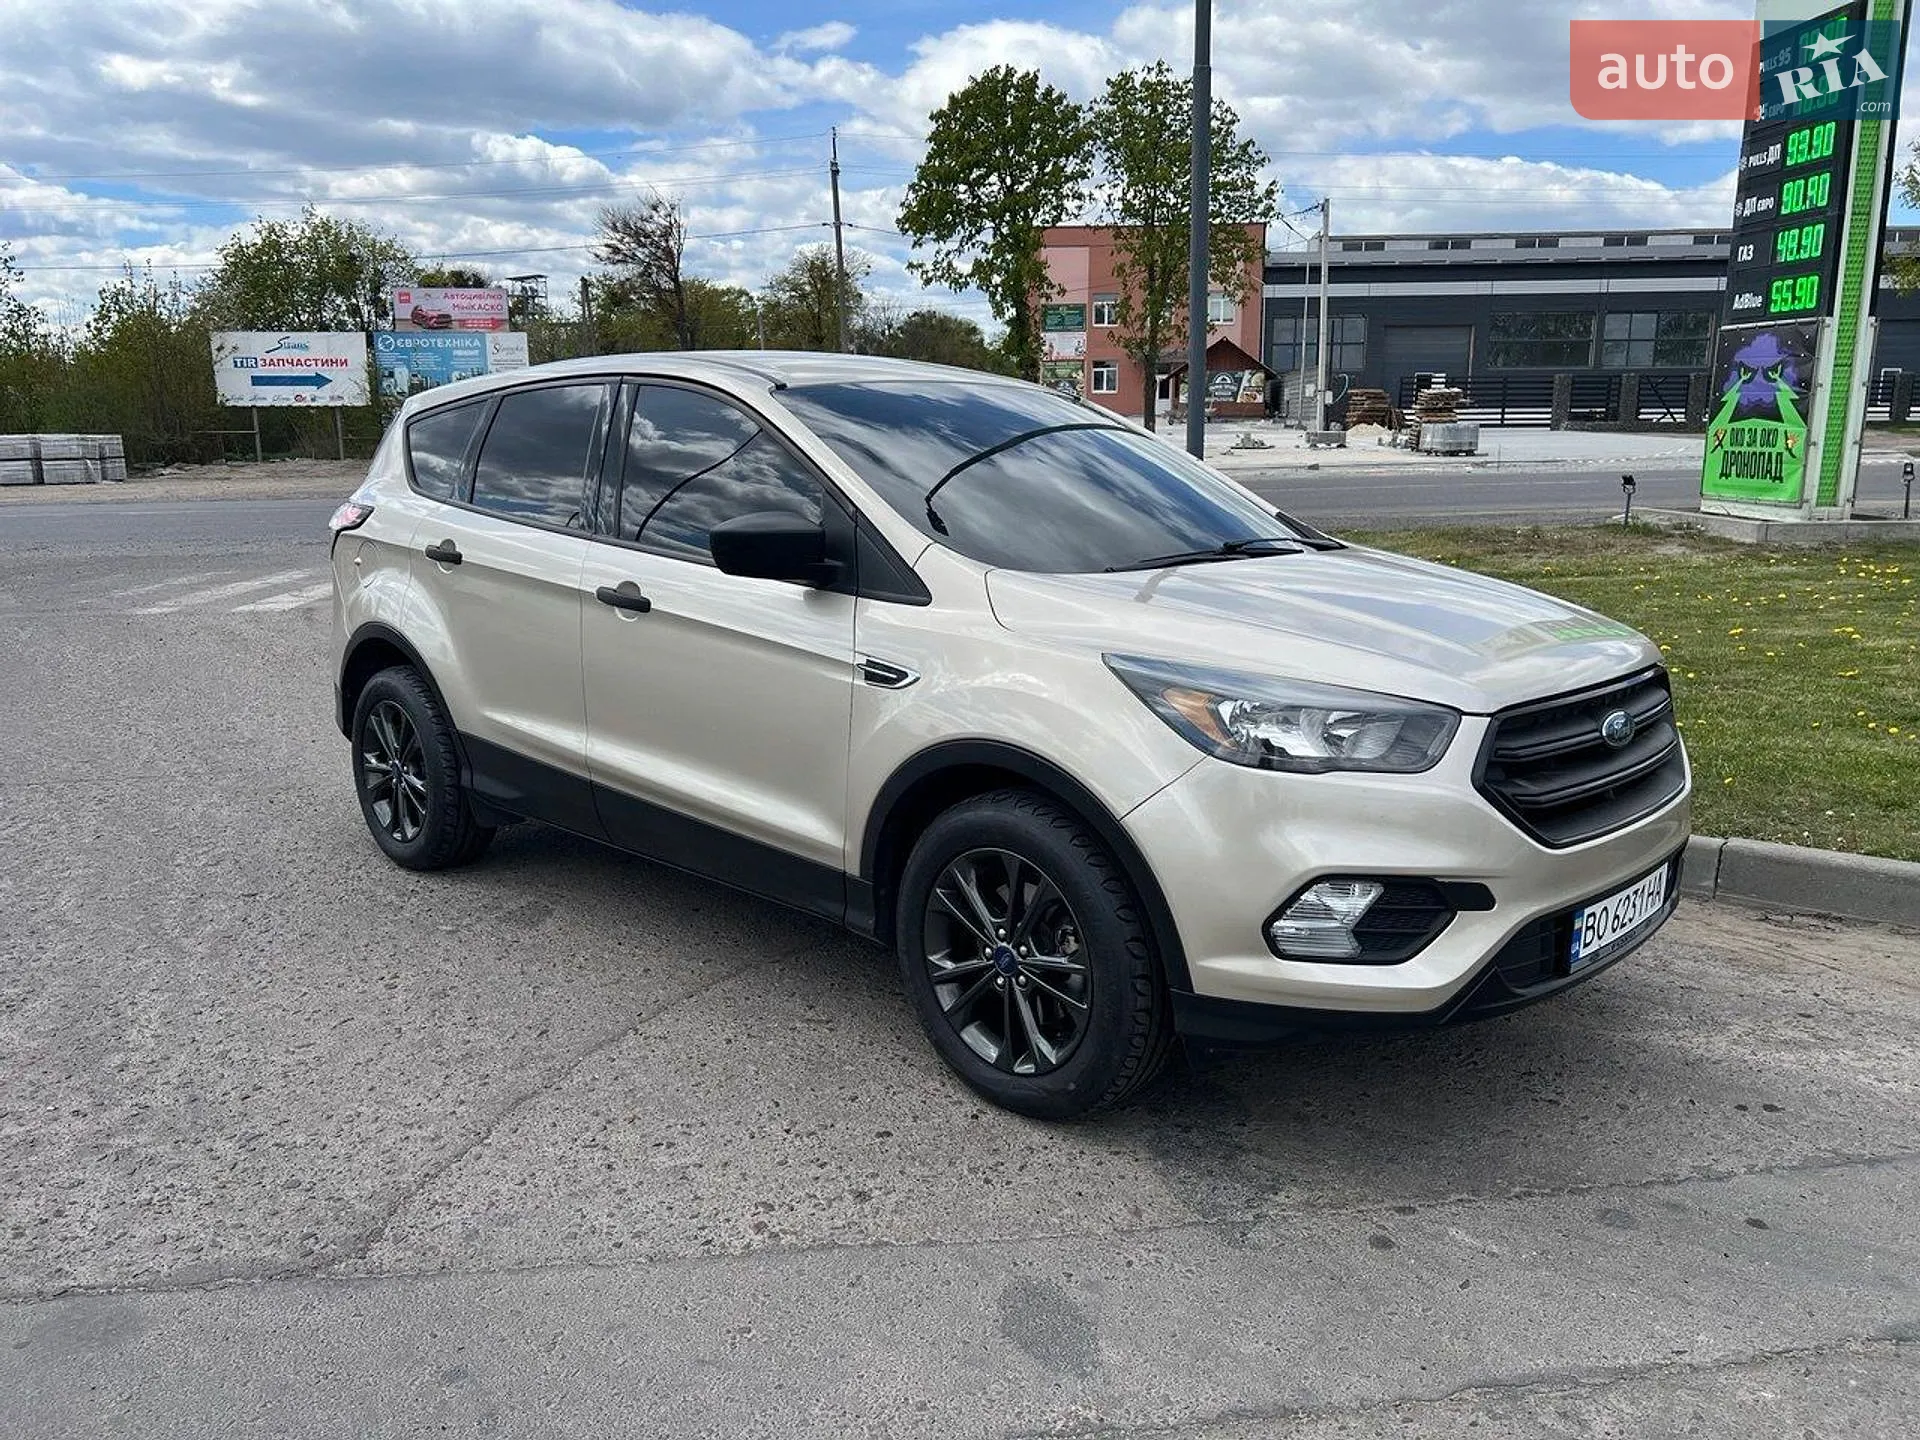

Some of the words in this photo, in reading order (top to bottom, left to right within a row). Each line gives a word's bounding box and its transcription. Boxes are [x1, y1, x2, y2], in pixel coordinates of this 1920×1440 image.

[1737, 244, 1754, 262] ГАЗ
[1776, 223, 1825, 262] 48.90
[1732, 292, 1763, 310] AdBlue
[1770, 276, 1819, 312] 55.90
[234, 358, 257, 368] TIR
[260, 358, 349, 368] ЗАПЧАСТИНИ
[1729, 427, 1745, 446] ОКО
[1746, 427, 1759, 446] ЗА
[1759, 427, 1778, 448] ОКО
[1719, 451, 1784, 484] ДРОНОПАД
[1583, 906, 1609, 949] BO
[1611, 885, 1645, 934] 6231
